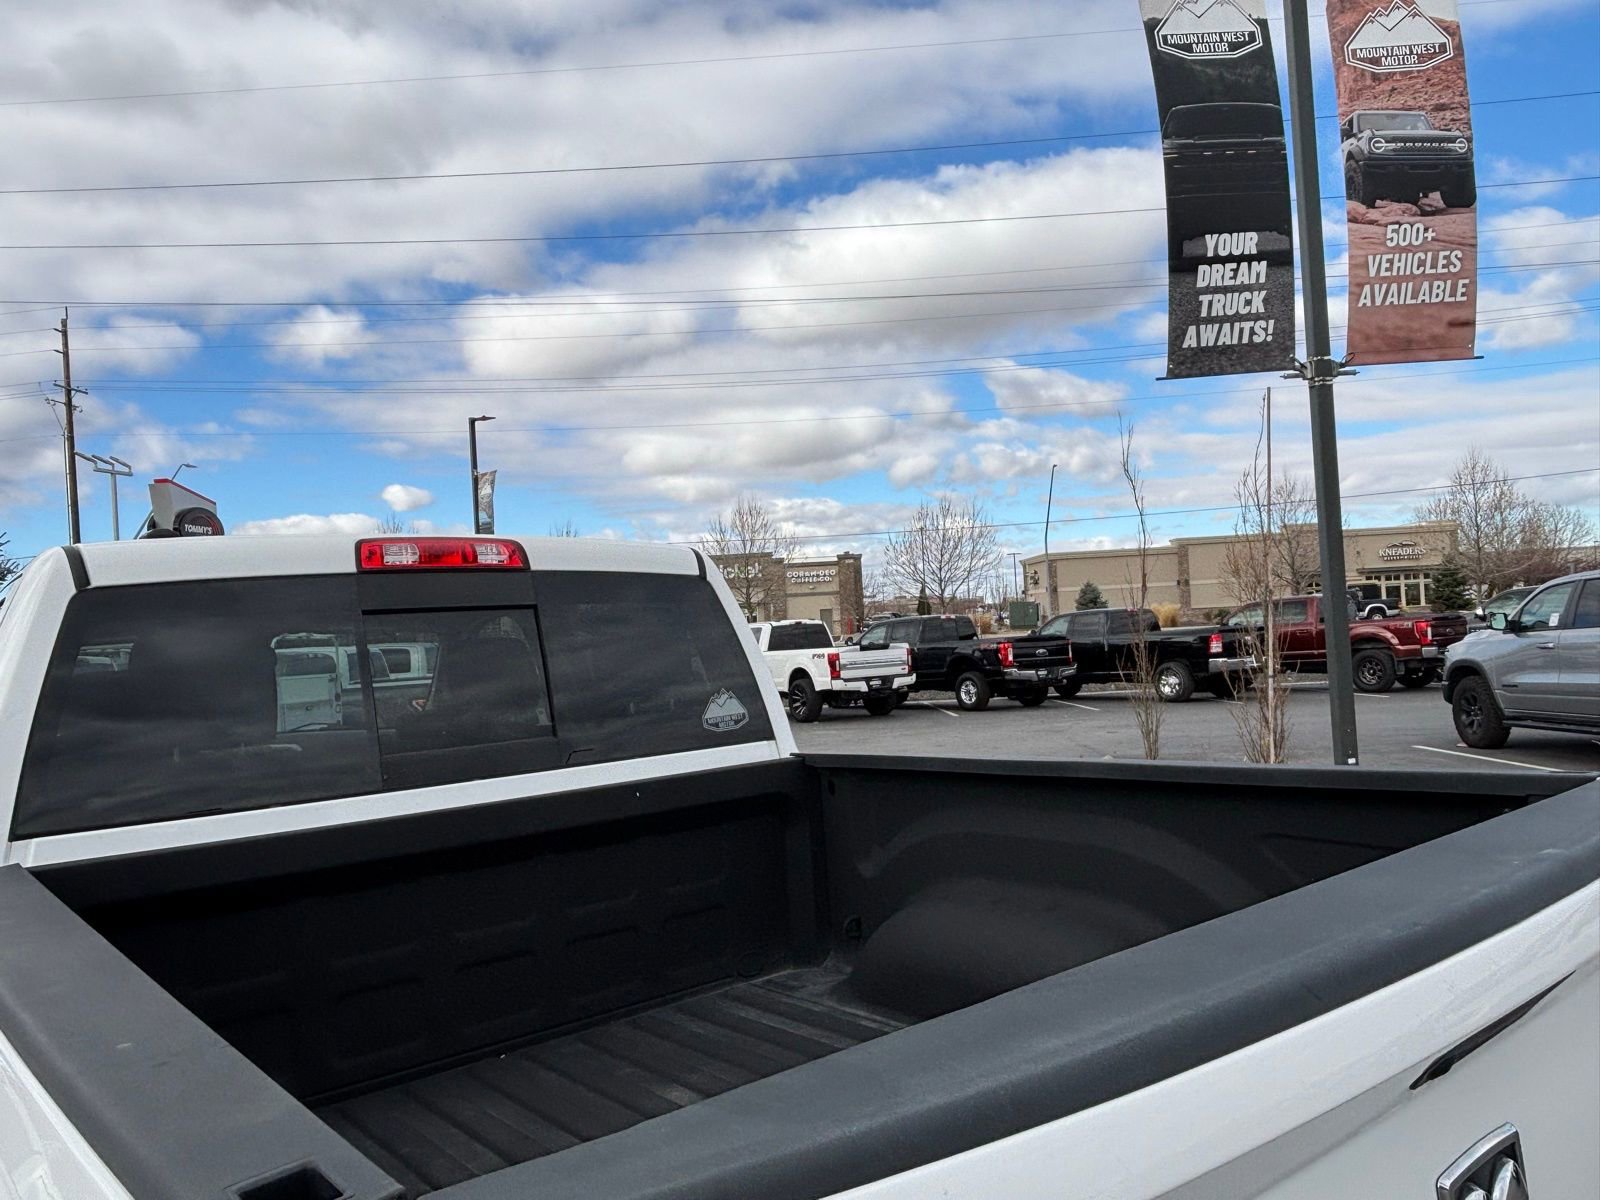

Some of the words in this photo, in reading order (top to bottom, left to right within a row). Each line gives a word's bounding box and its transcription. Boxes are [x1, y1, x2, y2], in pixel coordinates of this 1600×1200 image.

[1166, 32, 1221, 45] MOUNTAIN
[1221, 31, 1250, 42] WEST
[1192, 42, 1229, 53] MOTOR
[1356, 46, 1410, 58] MOUNTAIN
[1411, 43, 1440, 54] WEST
[1381, 55, 1418, 66] MOTOR
[1204, 231, 1259, 257] YOUR
[1385, 222, 1437, 247] 500+
[1196, 261, 1268, 288] DREAM
[1367, 250, 1463, 277] VEHICLES
[1198, 290, 1268, 317] TRUCK
[1357, 279, 1470, 307] AVAILABLE
[1181, 319, 1275, 348] AWAITS!
[184, 524, 212, 534] TOMMY'S
[1379, 546, 1426, 557] KNEADERS
